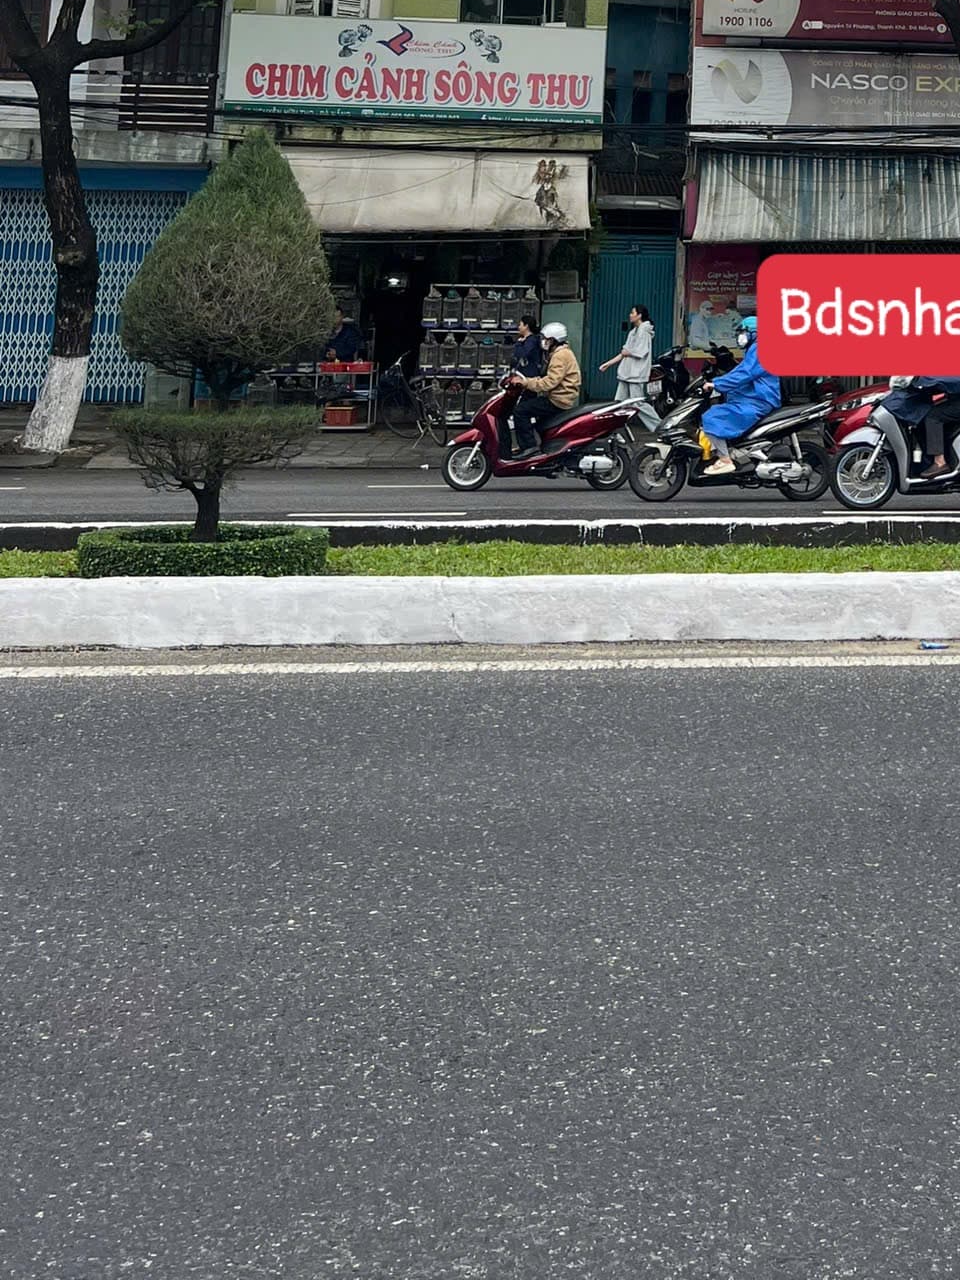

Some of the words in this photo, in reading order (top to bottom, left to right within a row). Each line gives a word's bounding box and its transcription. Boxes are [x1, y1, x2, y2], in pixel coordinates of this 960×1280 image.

[719, 16, 745, 27] 1900
[748, 18, 773, 28] 1106
[245, 62, 331, 100] CHIM
[334, 52, 429, 103] CẢNH
[433, 60, 521, 105] SÔNG
[526, 72, 594, 108] THU
[811, 73, 909, 91] NASCO
